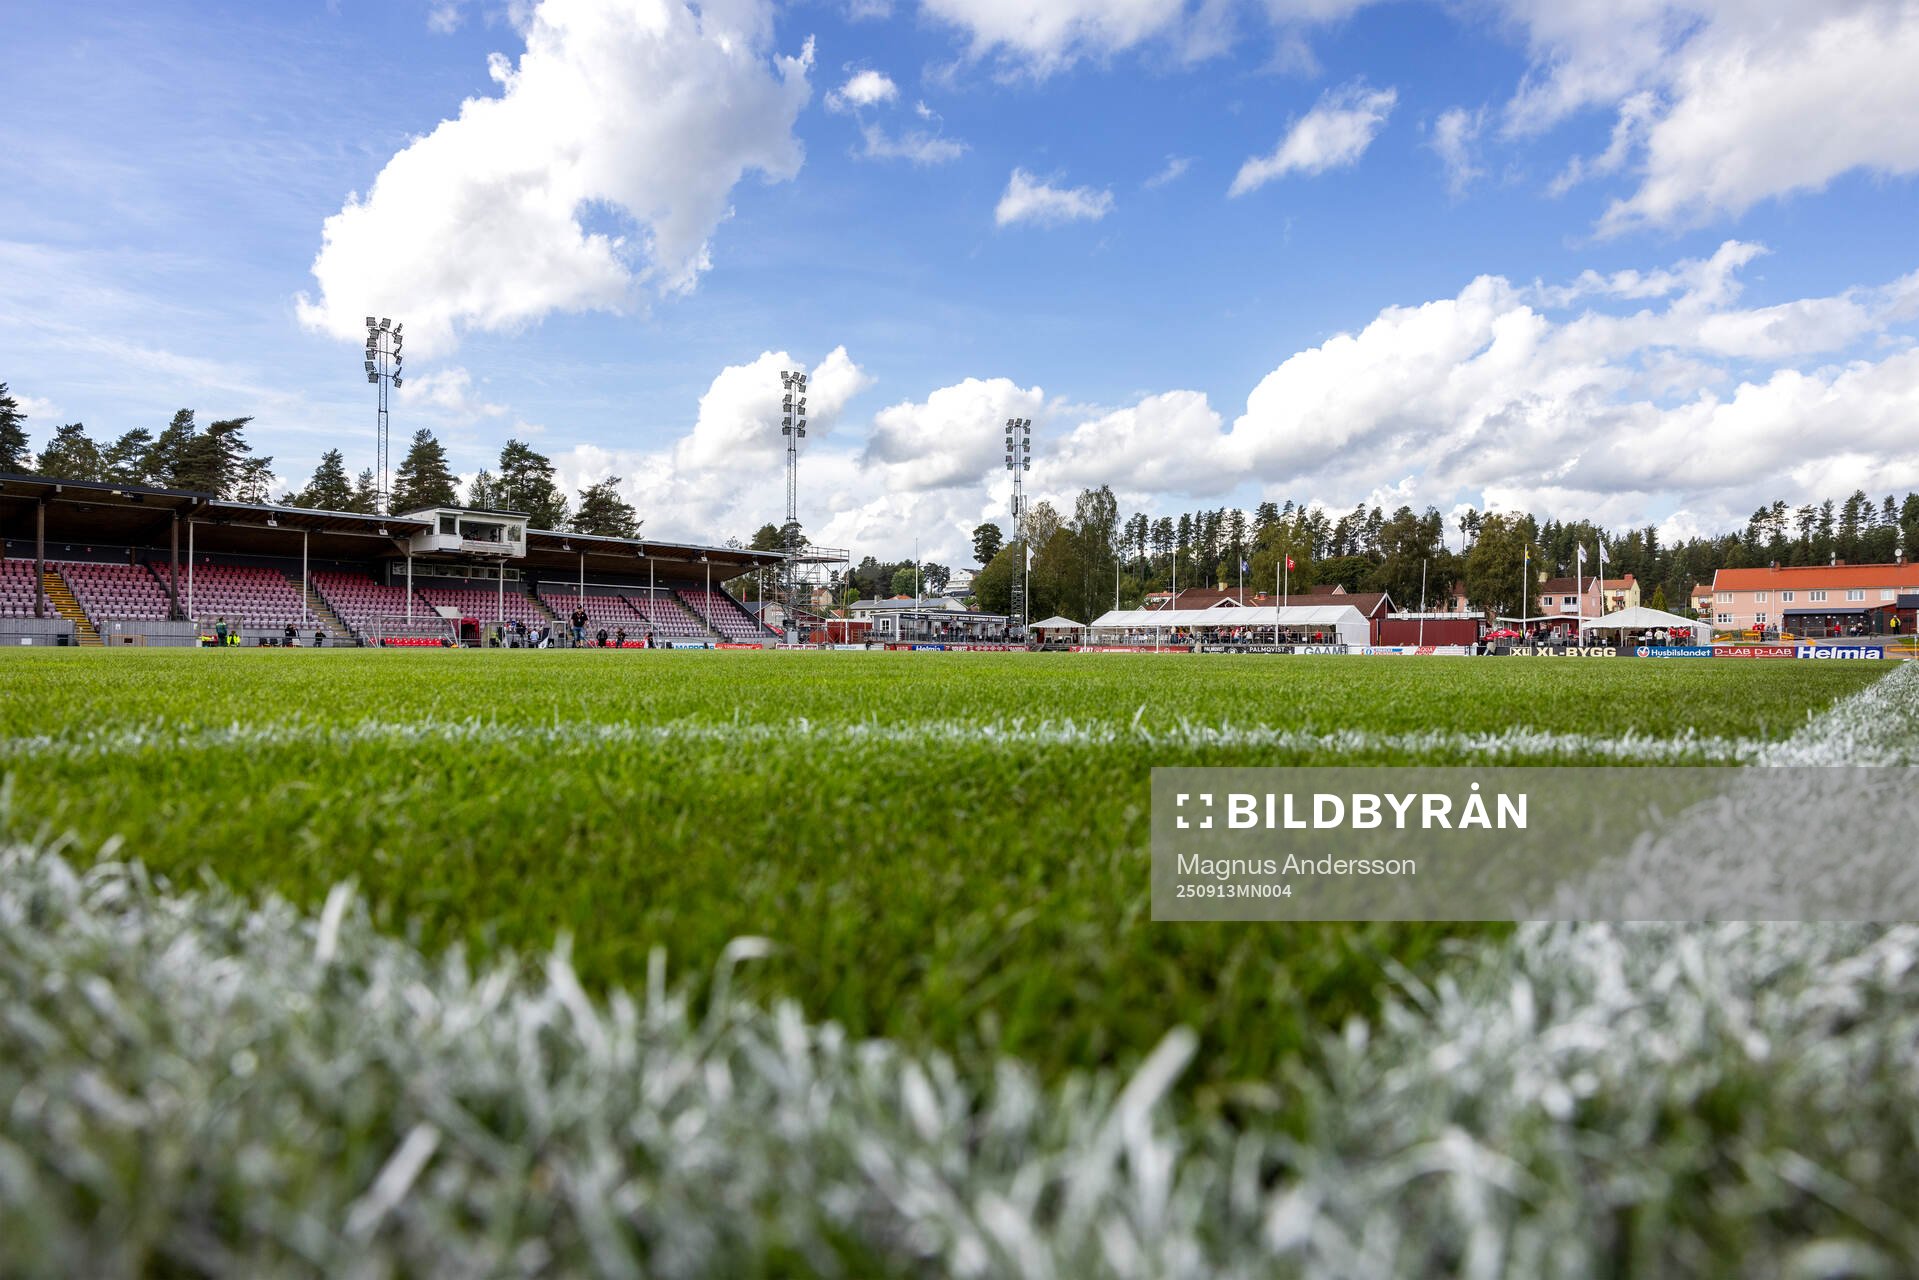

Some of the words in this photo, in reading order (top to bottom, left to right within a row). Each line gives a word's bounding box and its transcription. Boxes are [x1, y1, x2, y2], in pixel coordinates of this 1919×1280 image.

[1536, 647, 1617, 657] XL-BYGG
[1651, 649, 1711, 657] Husbilslandet
[1797, 646, 1881, 659] Helmia
